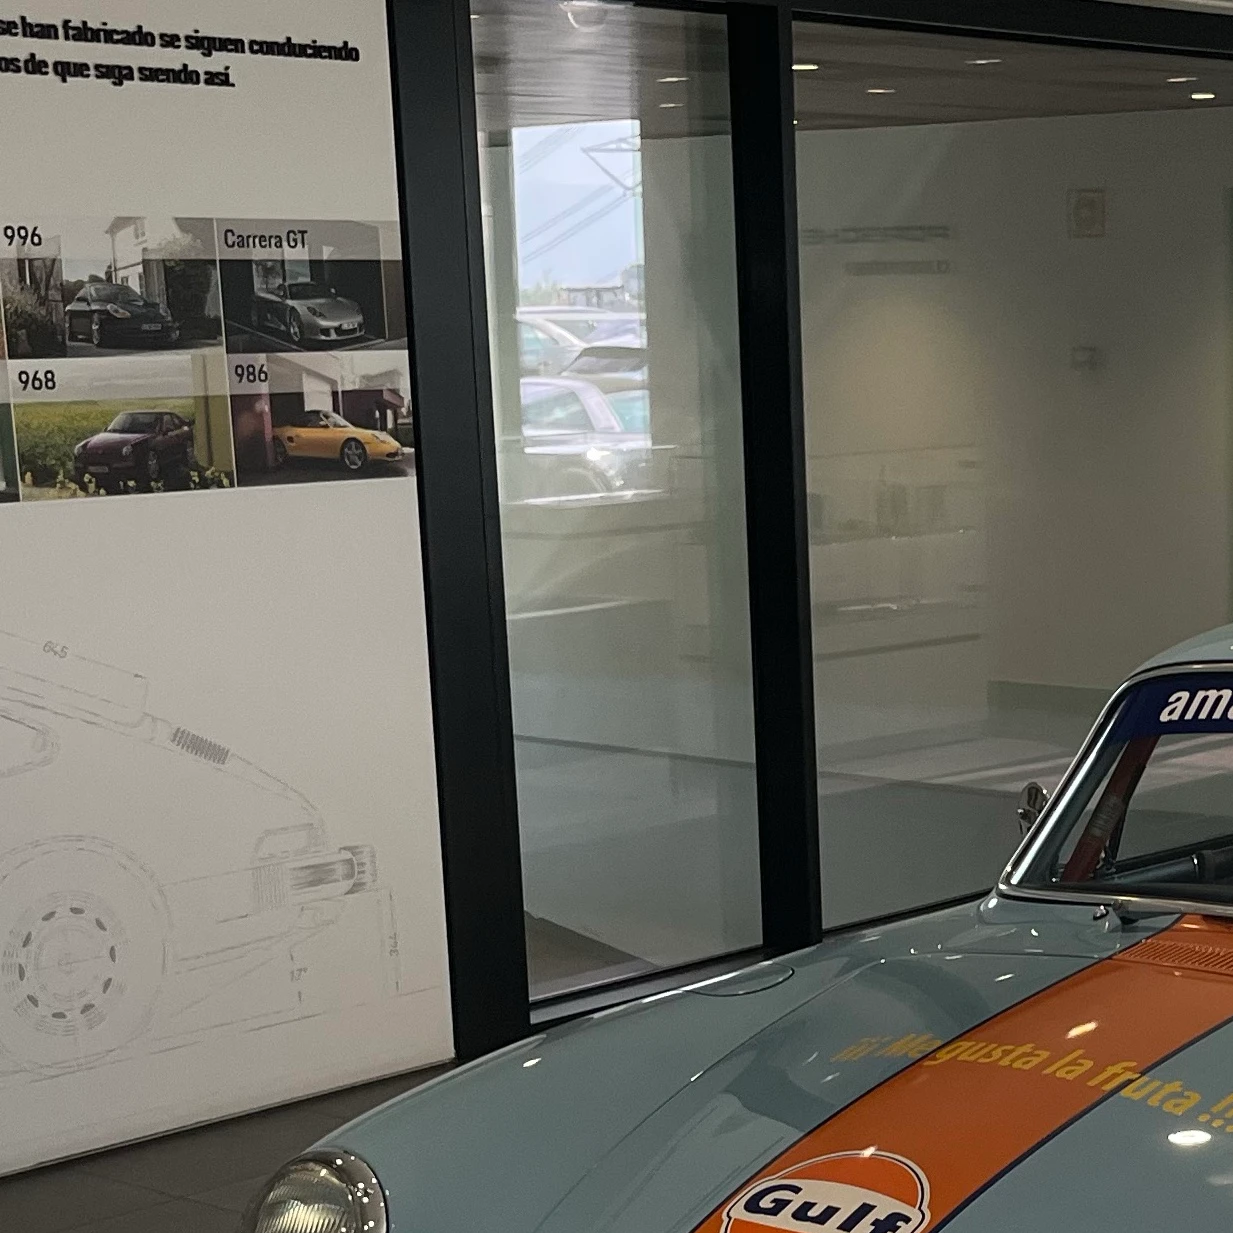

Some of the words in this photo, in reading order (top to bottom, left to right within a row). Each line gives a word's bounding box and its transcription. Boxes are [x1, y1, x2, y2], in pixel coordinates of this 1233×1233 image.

[20, 15, 59, 40] han
[62, 19, 156, 47] fabricado
[159, 32, 181, 49] se
[184, 29, 245, 57] siguen
[248, 36, 360, 62] conduciendo
[23, 52, 50, 75] de
[53, 60, 91, 83] que
[137, 63, 200, 85] siendo
[3, 226, 42, 247] 996
[224, 229, 283, 249] Carrera
[286, 230, 308, 249] GT
[18, 370, 56, 391] 968
[234, 364, 268, 383] 986
[923, 1040, 1051, 1070] gusta
[1042, 1049, 1094, 1080] la
[1087, 1061, 1202, 1116] fruta
